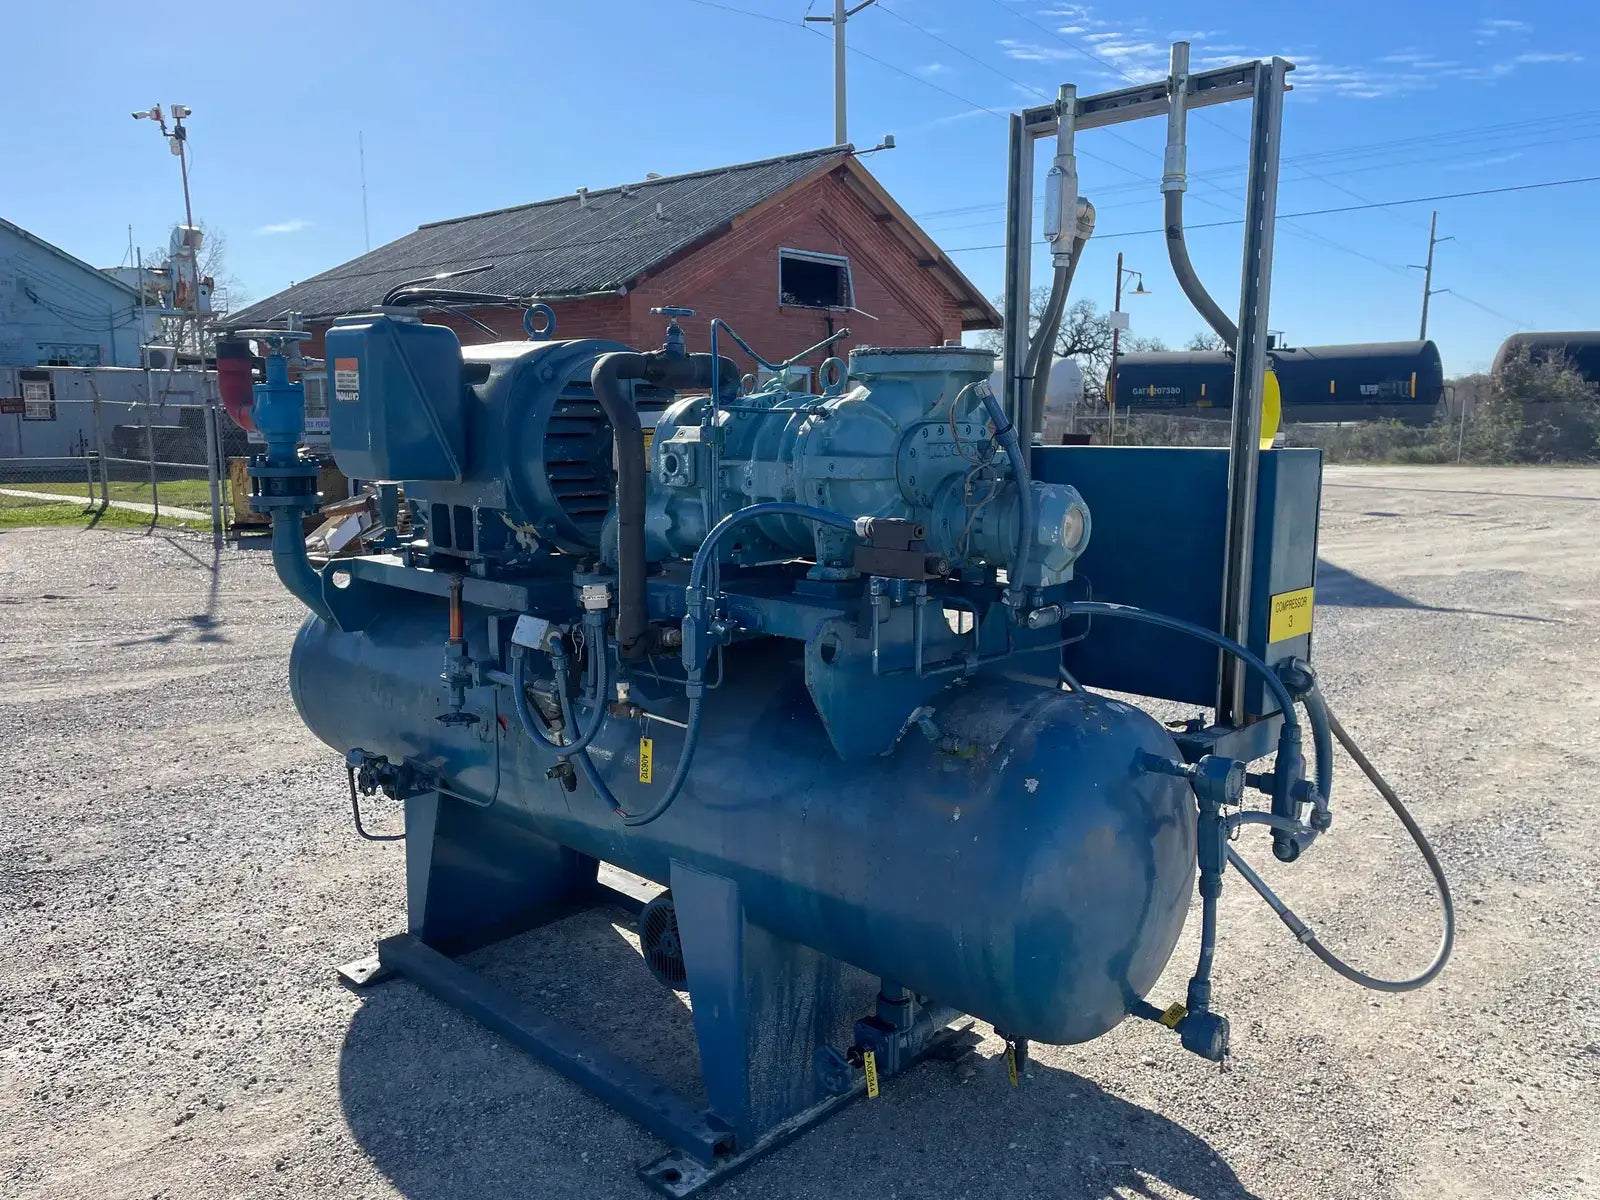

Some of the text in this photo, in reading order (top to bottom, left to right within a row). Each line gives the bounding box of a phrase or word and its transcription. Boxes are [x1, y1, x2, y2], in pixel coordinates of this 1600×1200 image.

[1275, 596, 1308, 613] COMPRESSOR
[1288, 614, 1294, 628] 3
[641, 753, 649, 779] A06312
[866, 1060, 876, 1092] A06344
